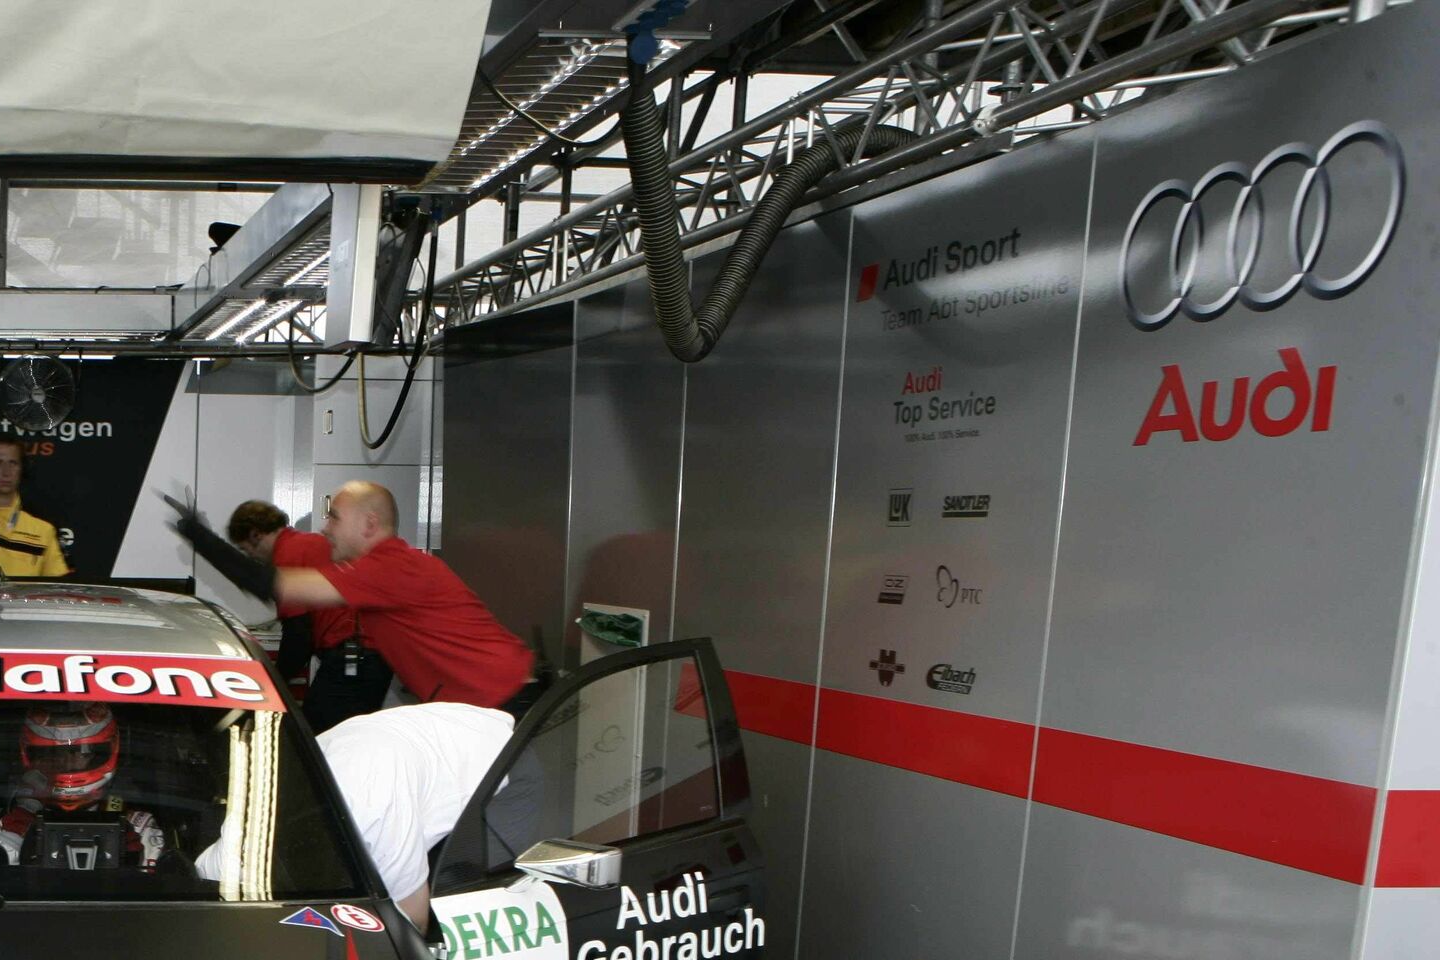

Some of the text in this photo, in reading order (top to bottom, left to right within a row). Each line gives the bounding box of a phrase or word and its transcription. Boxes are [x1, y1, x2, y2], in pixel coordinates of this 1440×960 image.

[884, 227, 1022, 291] Audi Sport
[881, 274, 1070, 332] Team Abt Sportsline
[901, 366, 943, 396] Audi
[1132, 347, 1338, 447] Audi
[893, 390, 996, 428] Top Service
[942, 494, 991, 512] SANDTLER
[926, 663, 977, 690] Eibach
[616, 871, 708, 931] Audi
